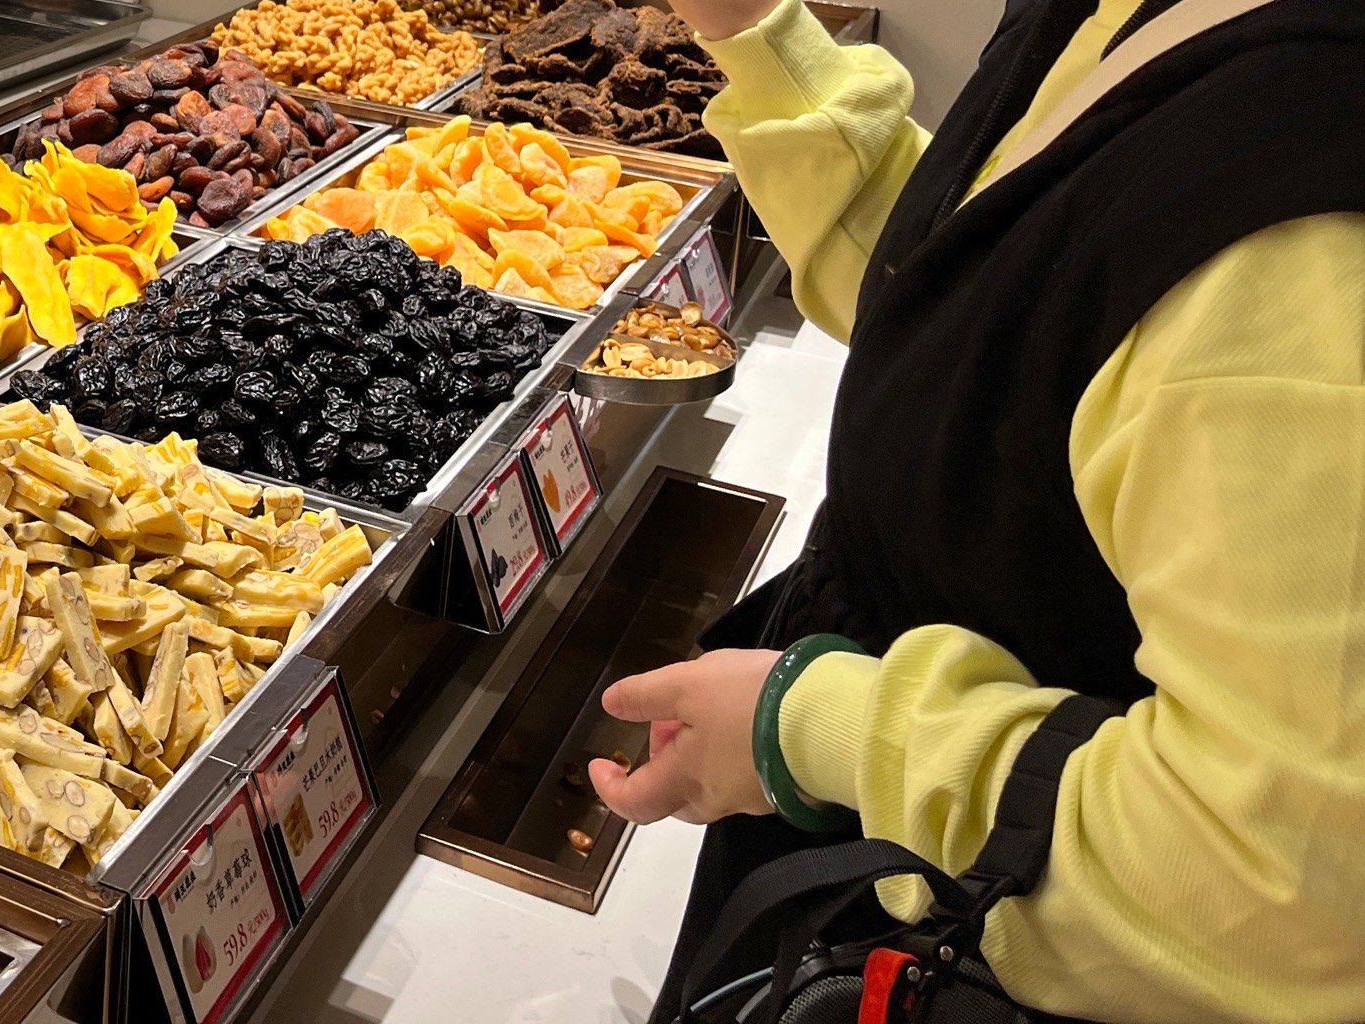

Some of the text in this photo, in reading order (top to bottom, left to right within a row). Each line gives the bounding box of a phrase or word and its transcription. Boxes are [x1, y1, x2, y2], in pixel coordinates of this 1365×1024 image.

[318, 801, 339, 838] 59.8
[206, 848, 253, 912] 奶香草莓球
[223, 923, 247, 967] 59.8
